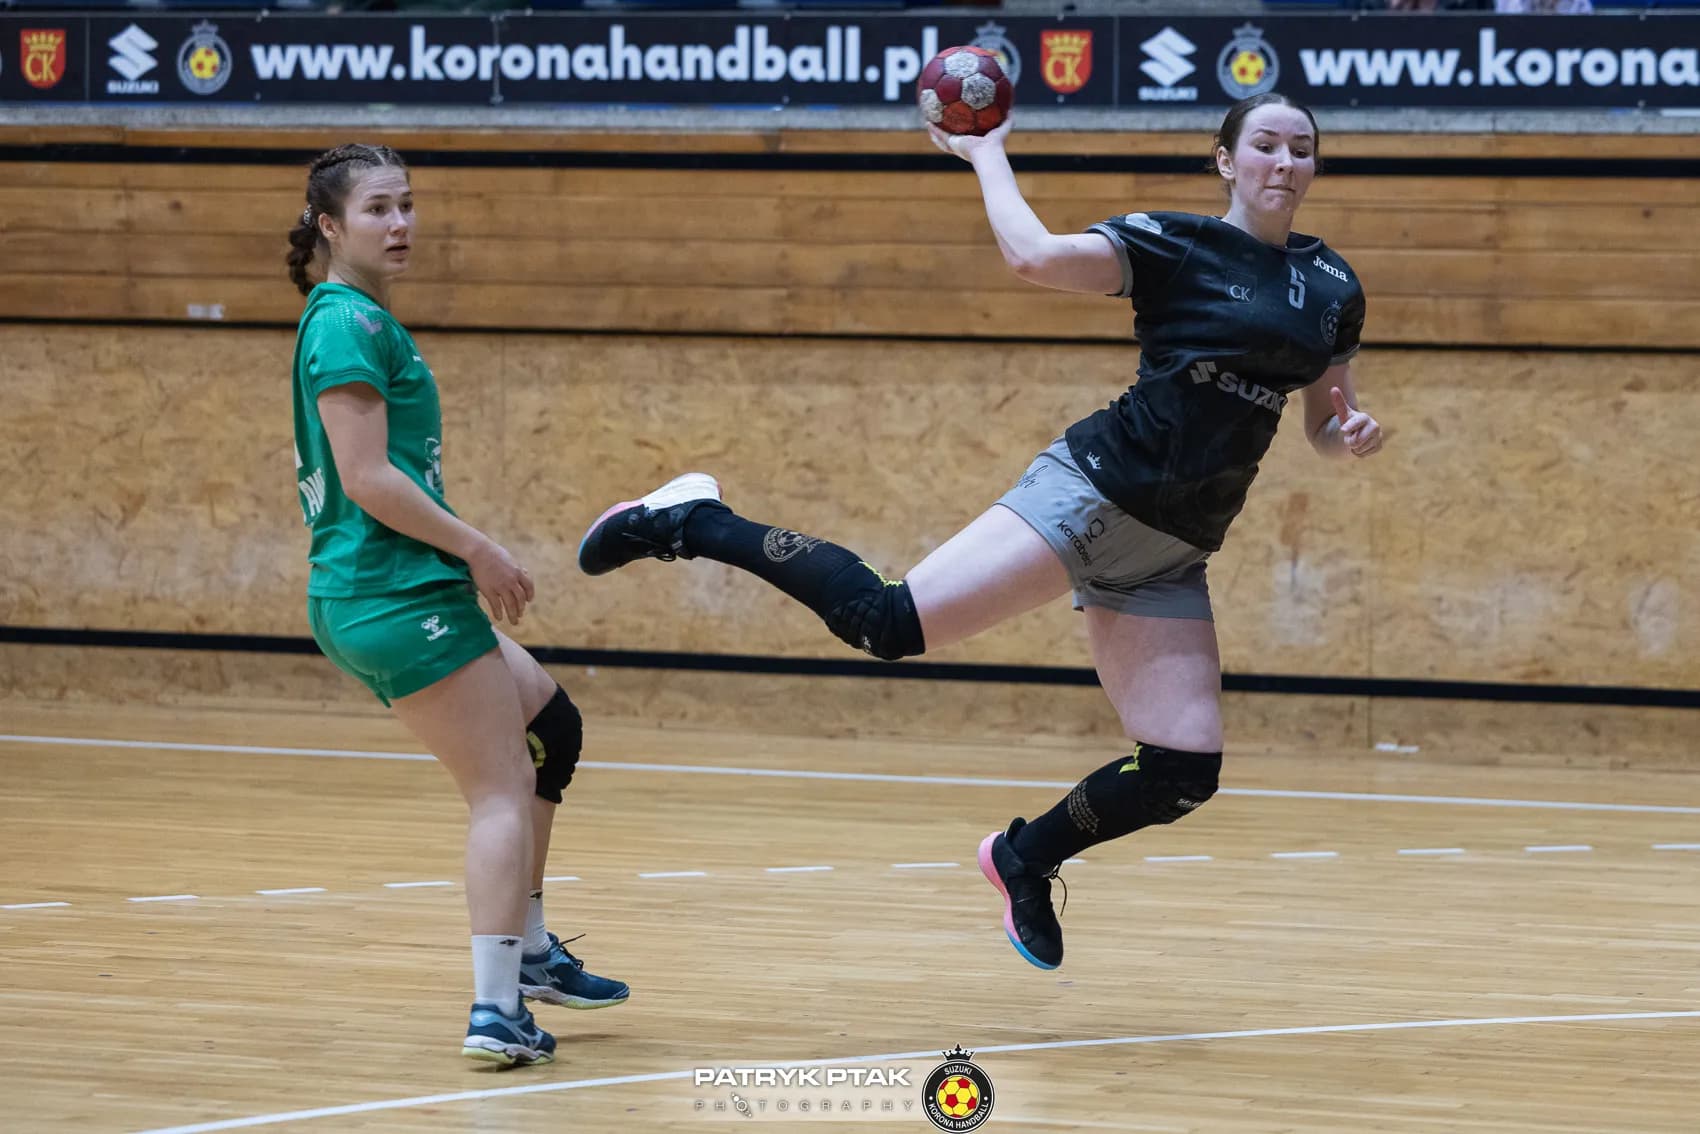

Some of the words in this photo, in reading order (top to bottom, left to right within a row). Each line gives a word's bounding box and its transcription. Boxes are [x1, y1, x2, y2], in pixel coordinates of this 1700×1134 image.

[250, 26, 939, 100] www.koronahandball.pl
[1300, 28, 1700, 87] www.korona
[1288, 264, 1306, 310] 5
[1312, 255, 1349, 283] Joma
[1229, 284, 1251, 302] CK
